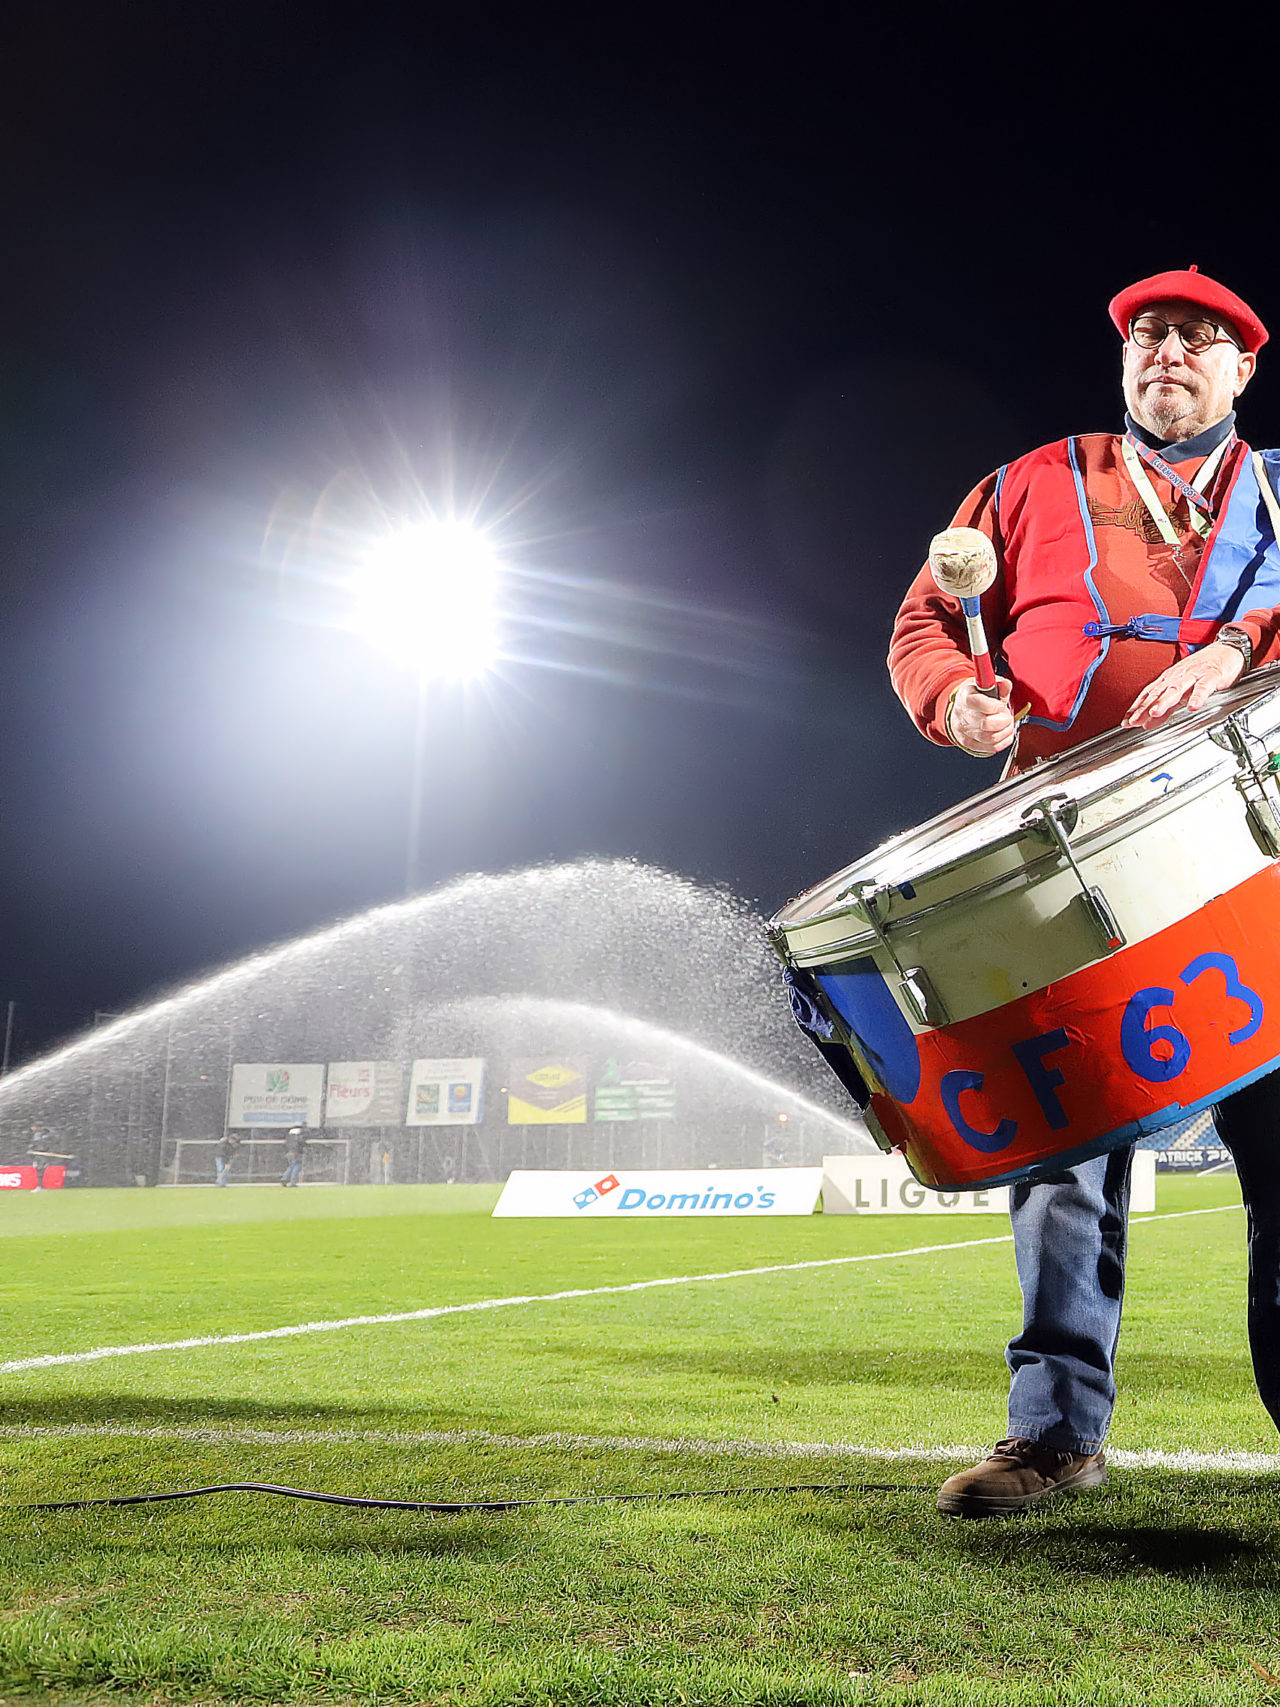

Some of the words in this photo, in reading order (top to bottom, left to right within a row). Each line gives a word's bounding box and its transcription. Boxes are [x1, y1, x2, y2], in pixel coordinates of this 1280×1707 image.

[1153, 460, 1183, 487] CLERMONT
[1180, 483, 1198, 499] FOOT
[940, 1026, 1071, 1154] CF
[1120, 952, 1264, 1082] 63
[329, 1084, 370, 1098] Fleurs
[1155, 1150, 1203, 1162] PATRICK
[617, 1185, 776, 1210] Domino's
